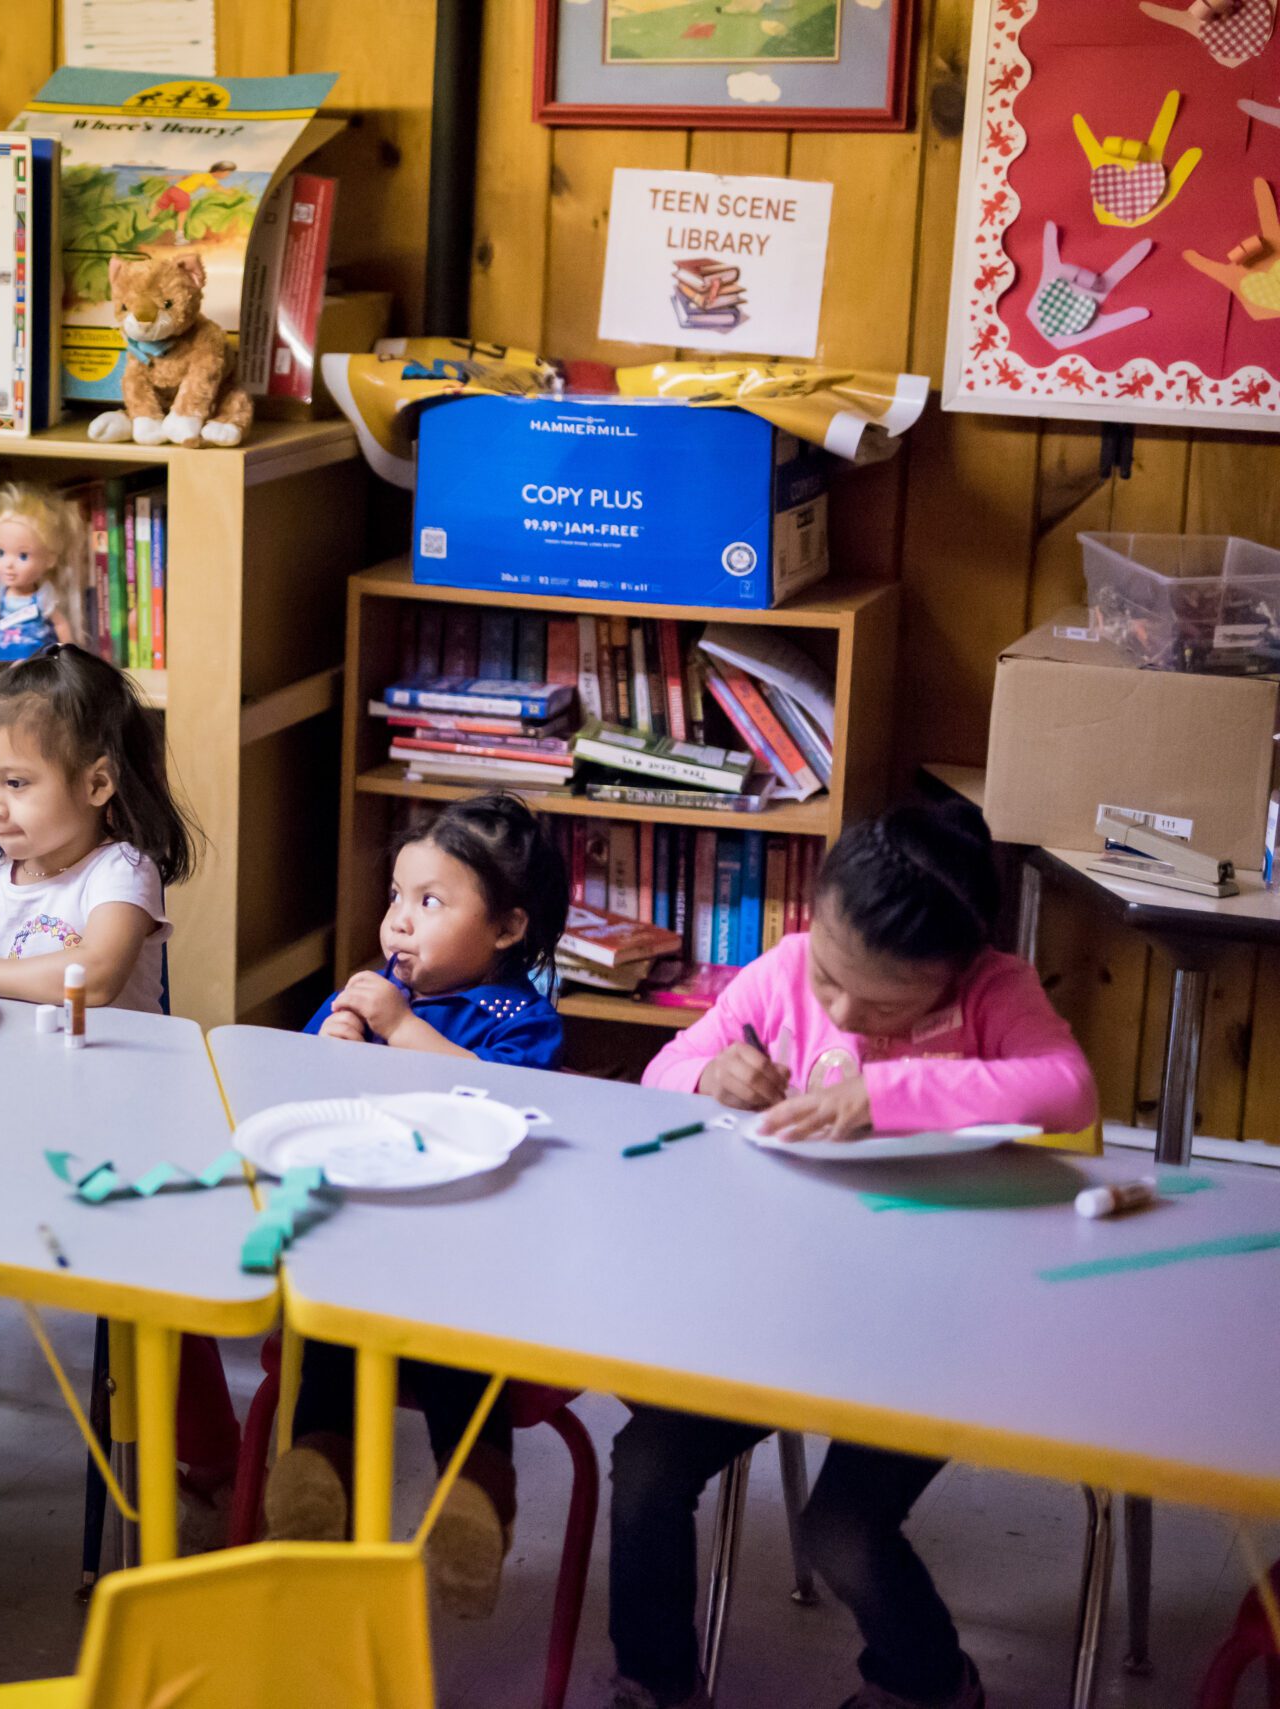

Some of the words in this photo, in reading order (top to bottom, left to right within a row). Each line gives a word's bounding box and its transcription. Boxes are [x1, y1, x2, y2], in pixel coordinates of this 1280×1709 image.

[73, 119, 154, 132] Where's
[162, 122, 245, 138] Henry?
[649, 188, 710, 214] TEEN
[716, 194, 798, 222] SCENE
[666, 226, 771, 256] LIBRARY
[529, 420, 639, 437] HAMMERMILL
[521, 484, 584, 507] COPY
[591, 488, 644, 510] PLUS
